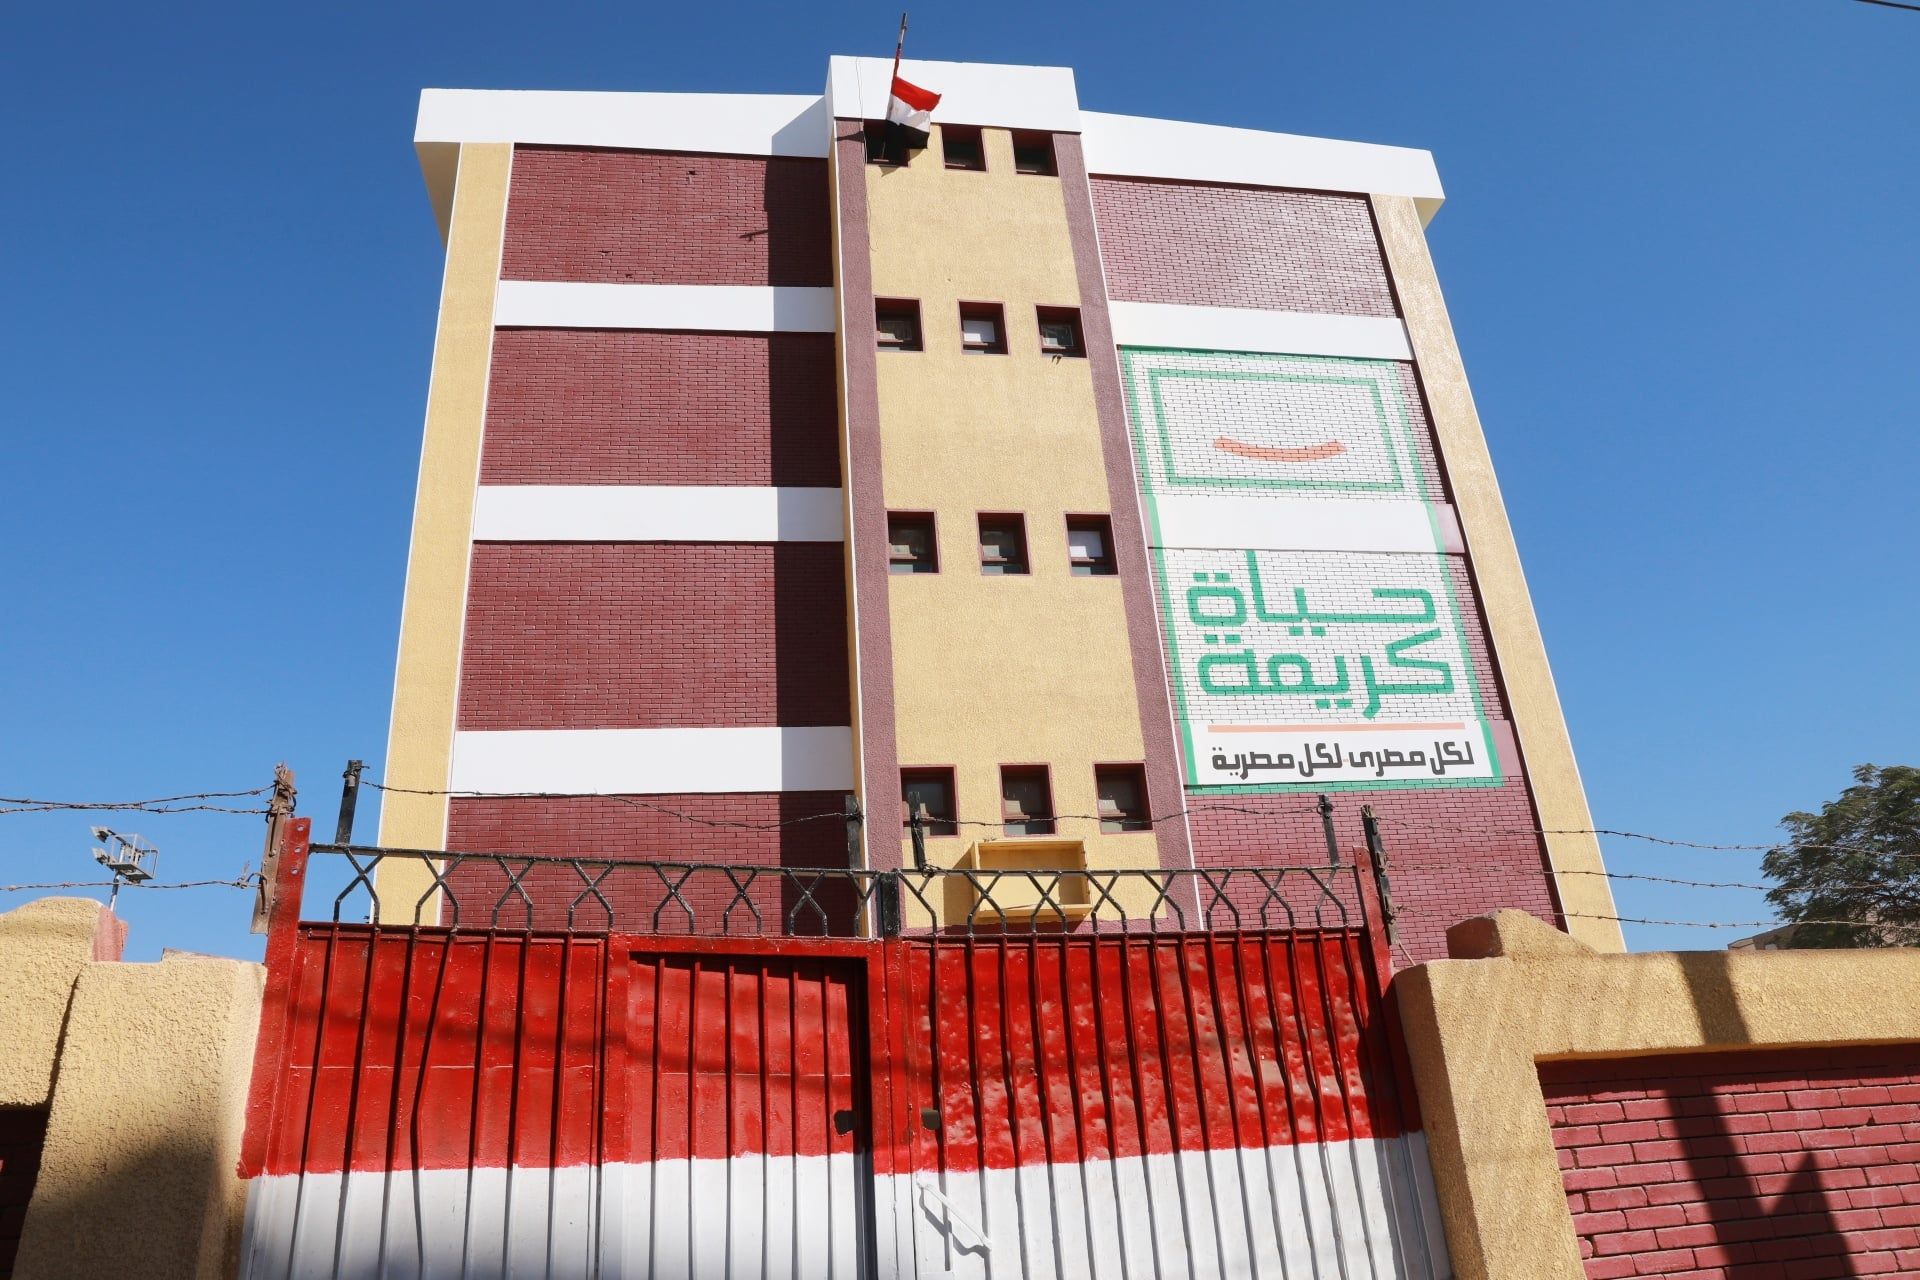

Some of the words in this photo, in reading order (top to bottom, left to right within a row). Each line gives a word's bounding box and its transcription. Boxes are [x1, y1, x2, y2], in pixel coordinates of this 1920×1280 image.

[1186, 549, 1436, 637] حياة
[1197, 628, 1454, 719] كريمة
[1212, 746, 1295, 780] مصرية
[1298, 743, 1342, 777] لكل
[1429, 741, 1474, 775] لكل
